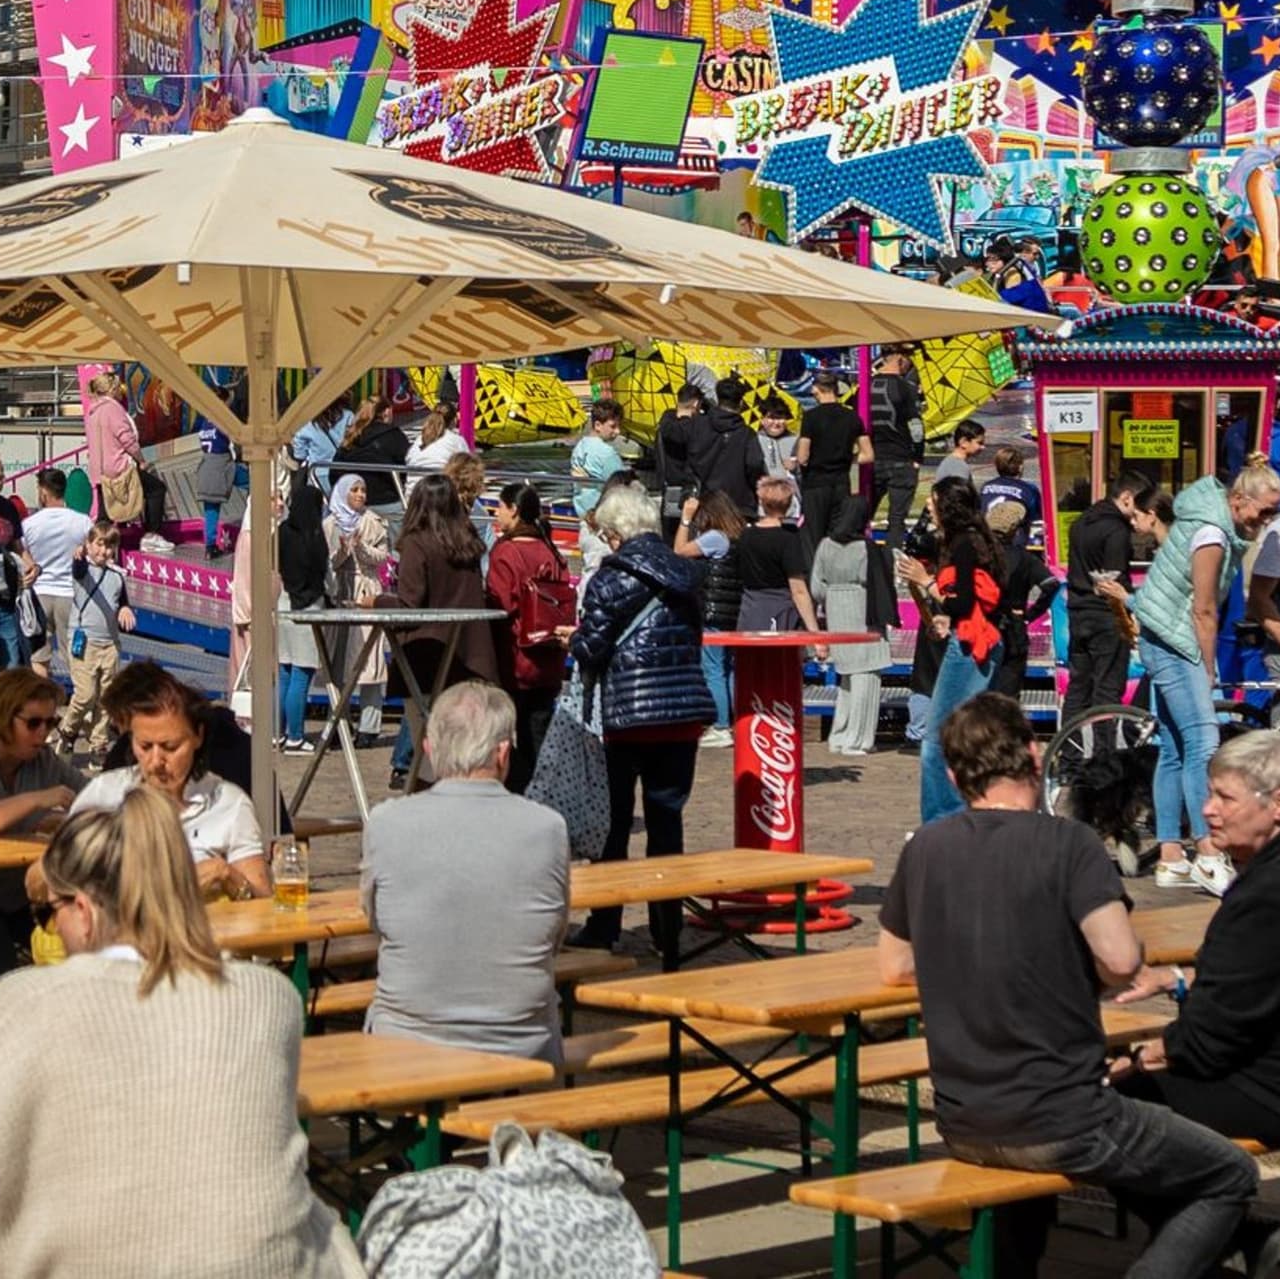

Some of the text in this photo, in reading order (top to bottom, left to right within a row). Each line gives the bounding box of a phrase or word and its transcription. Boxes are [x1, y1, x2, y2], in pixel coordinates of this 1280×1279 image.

[128, 28, 179, 73] NUGGET
[705, 54, 775, 94] CASIN
[734, 72, 870, 146] BREAK
[836, 76, 1004, 159] DANCER
[581, 137, 675, 164] R.Schramm
[1059, 411, 1083, 425] K13
